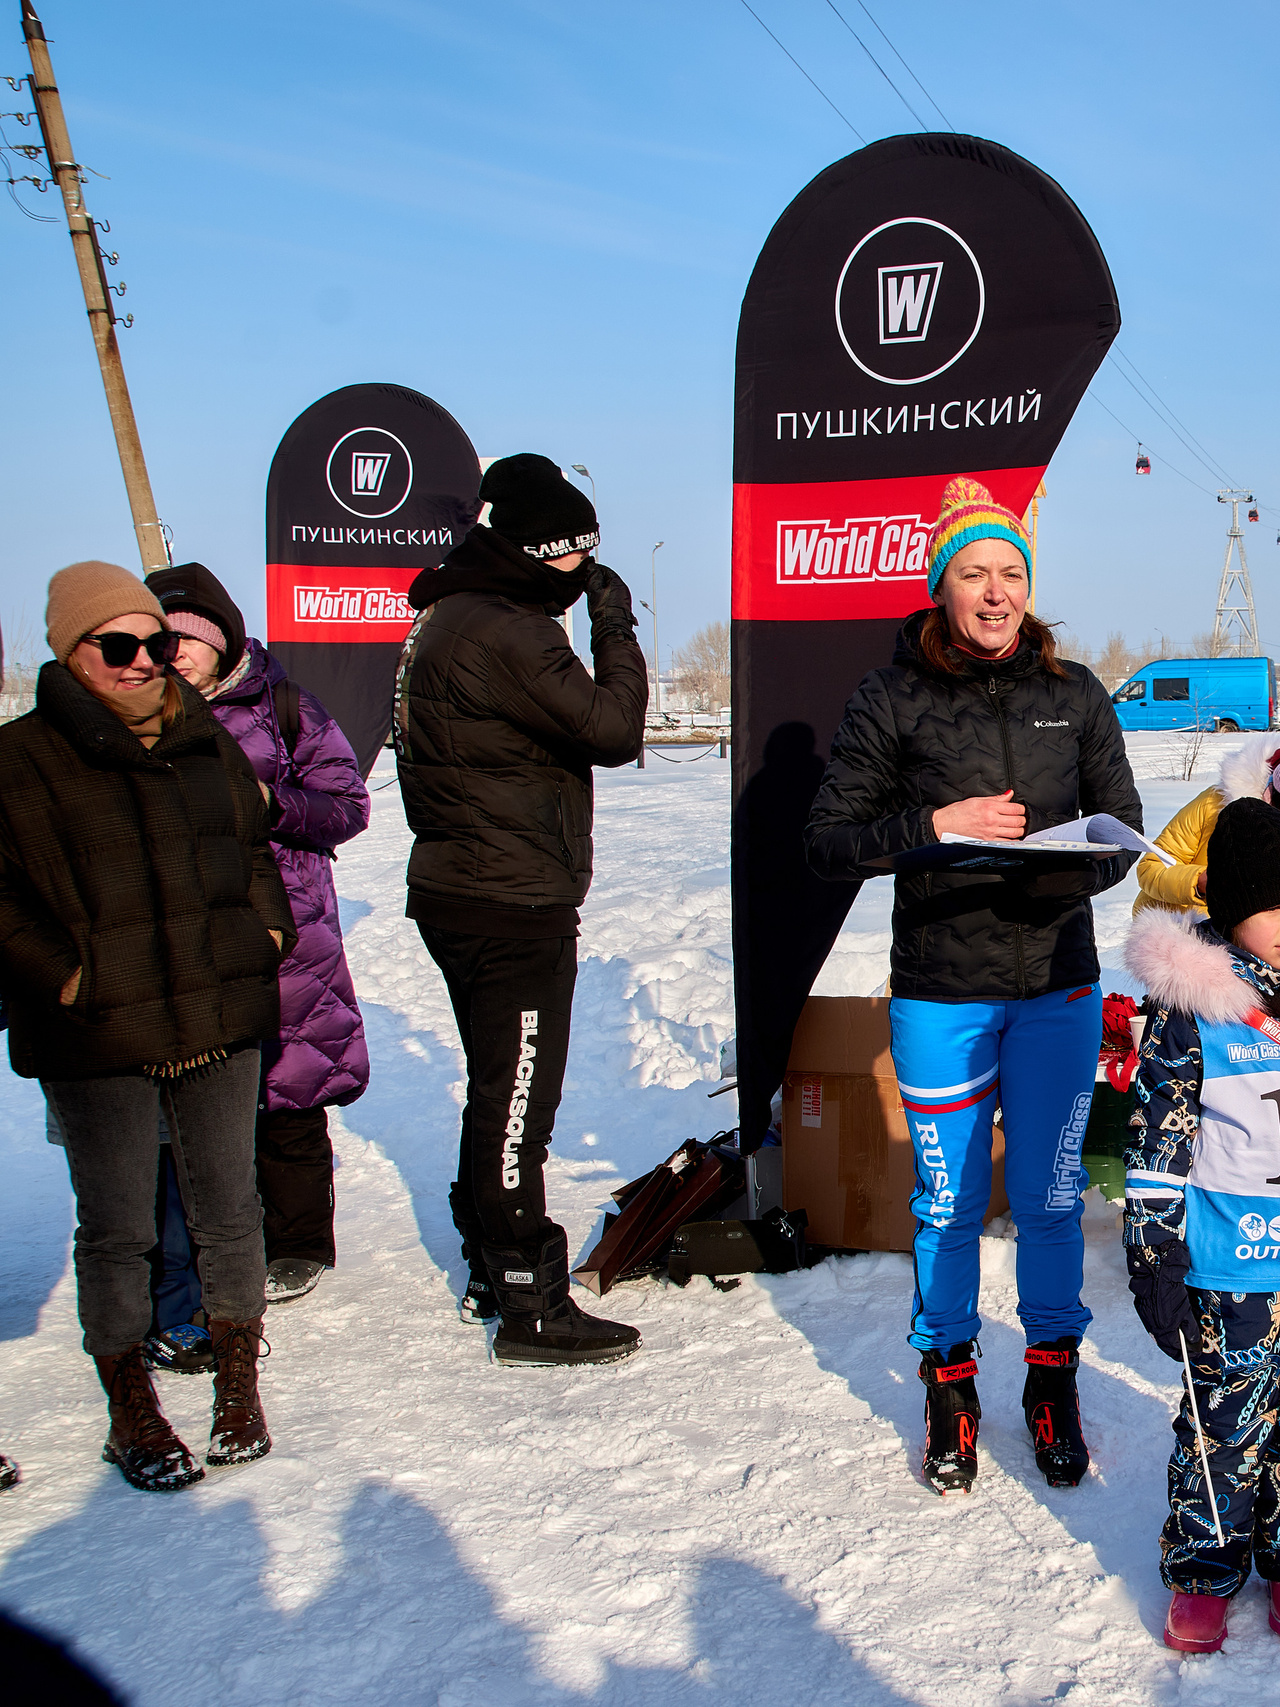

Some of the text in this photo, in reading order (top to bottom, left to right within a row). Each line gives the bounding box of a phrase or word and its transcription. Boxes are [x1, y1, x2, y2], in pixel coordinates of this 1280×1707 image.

[887, 273, 931, 333] W
[776, 388, 1042, 440] ПУШКИНСКИЙ
[356, 458, 384, 490] W
[291, 525, 453, 546] ПУШКИНСКИЙ
[784, 523, 930, 576] World Cla
[298, 590, 362, 619] World
[1039, 719, 1070, 728] Columbia
[1229, 1043, 1260, 1061] World
[501, 1010, 538, 1190] BLACKSQUAD
[1049, 1095, 1092, 1208] World Class
[507, 1273, 531, 1282] ALASKA
